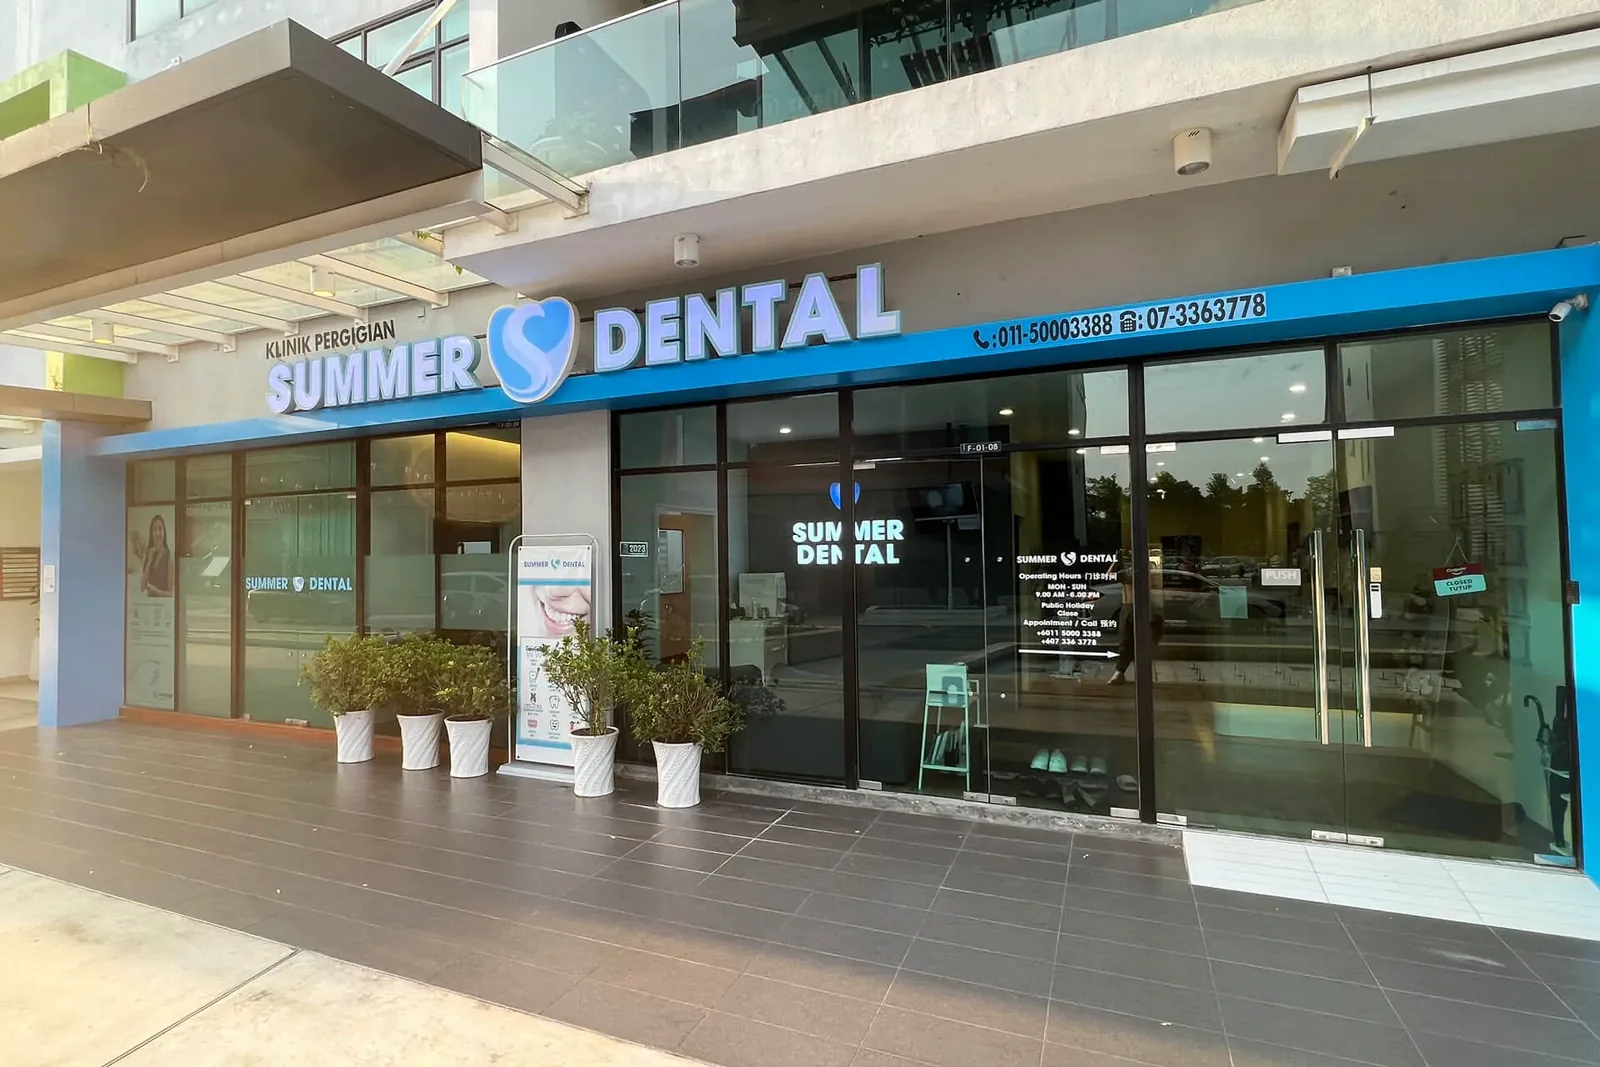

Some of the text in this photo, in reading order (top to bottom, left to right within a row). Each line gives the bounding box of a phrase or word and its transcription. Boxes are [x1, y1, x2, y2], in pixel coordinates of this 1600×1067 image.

[266, 335, 483, 414] SUMMER
[594, 262, 901, 373] DENTAL
[266, 320, 396, 359] KLINIK PERGIGIAN
[629, 544, 646, 553] 2023
[1016, 554, 1118, 564] SUMMER DENTAL
[1019, 572, 1057, 581] Operating
[1265, 570, 1297, 580] PUSH
[245, 577, 353, 591] SUMMER DENTAL
[1065, 602, 1095, 610] Holiday
[1023, 619, 1073, 628] Appointment
